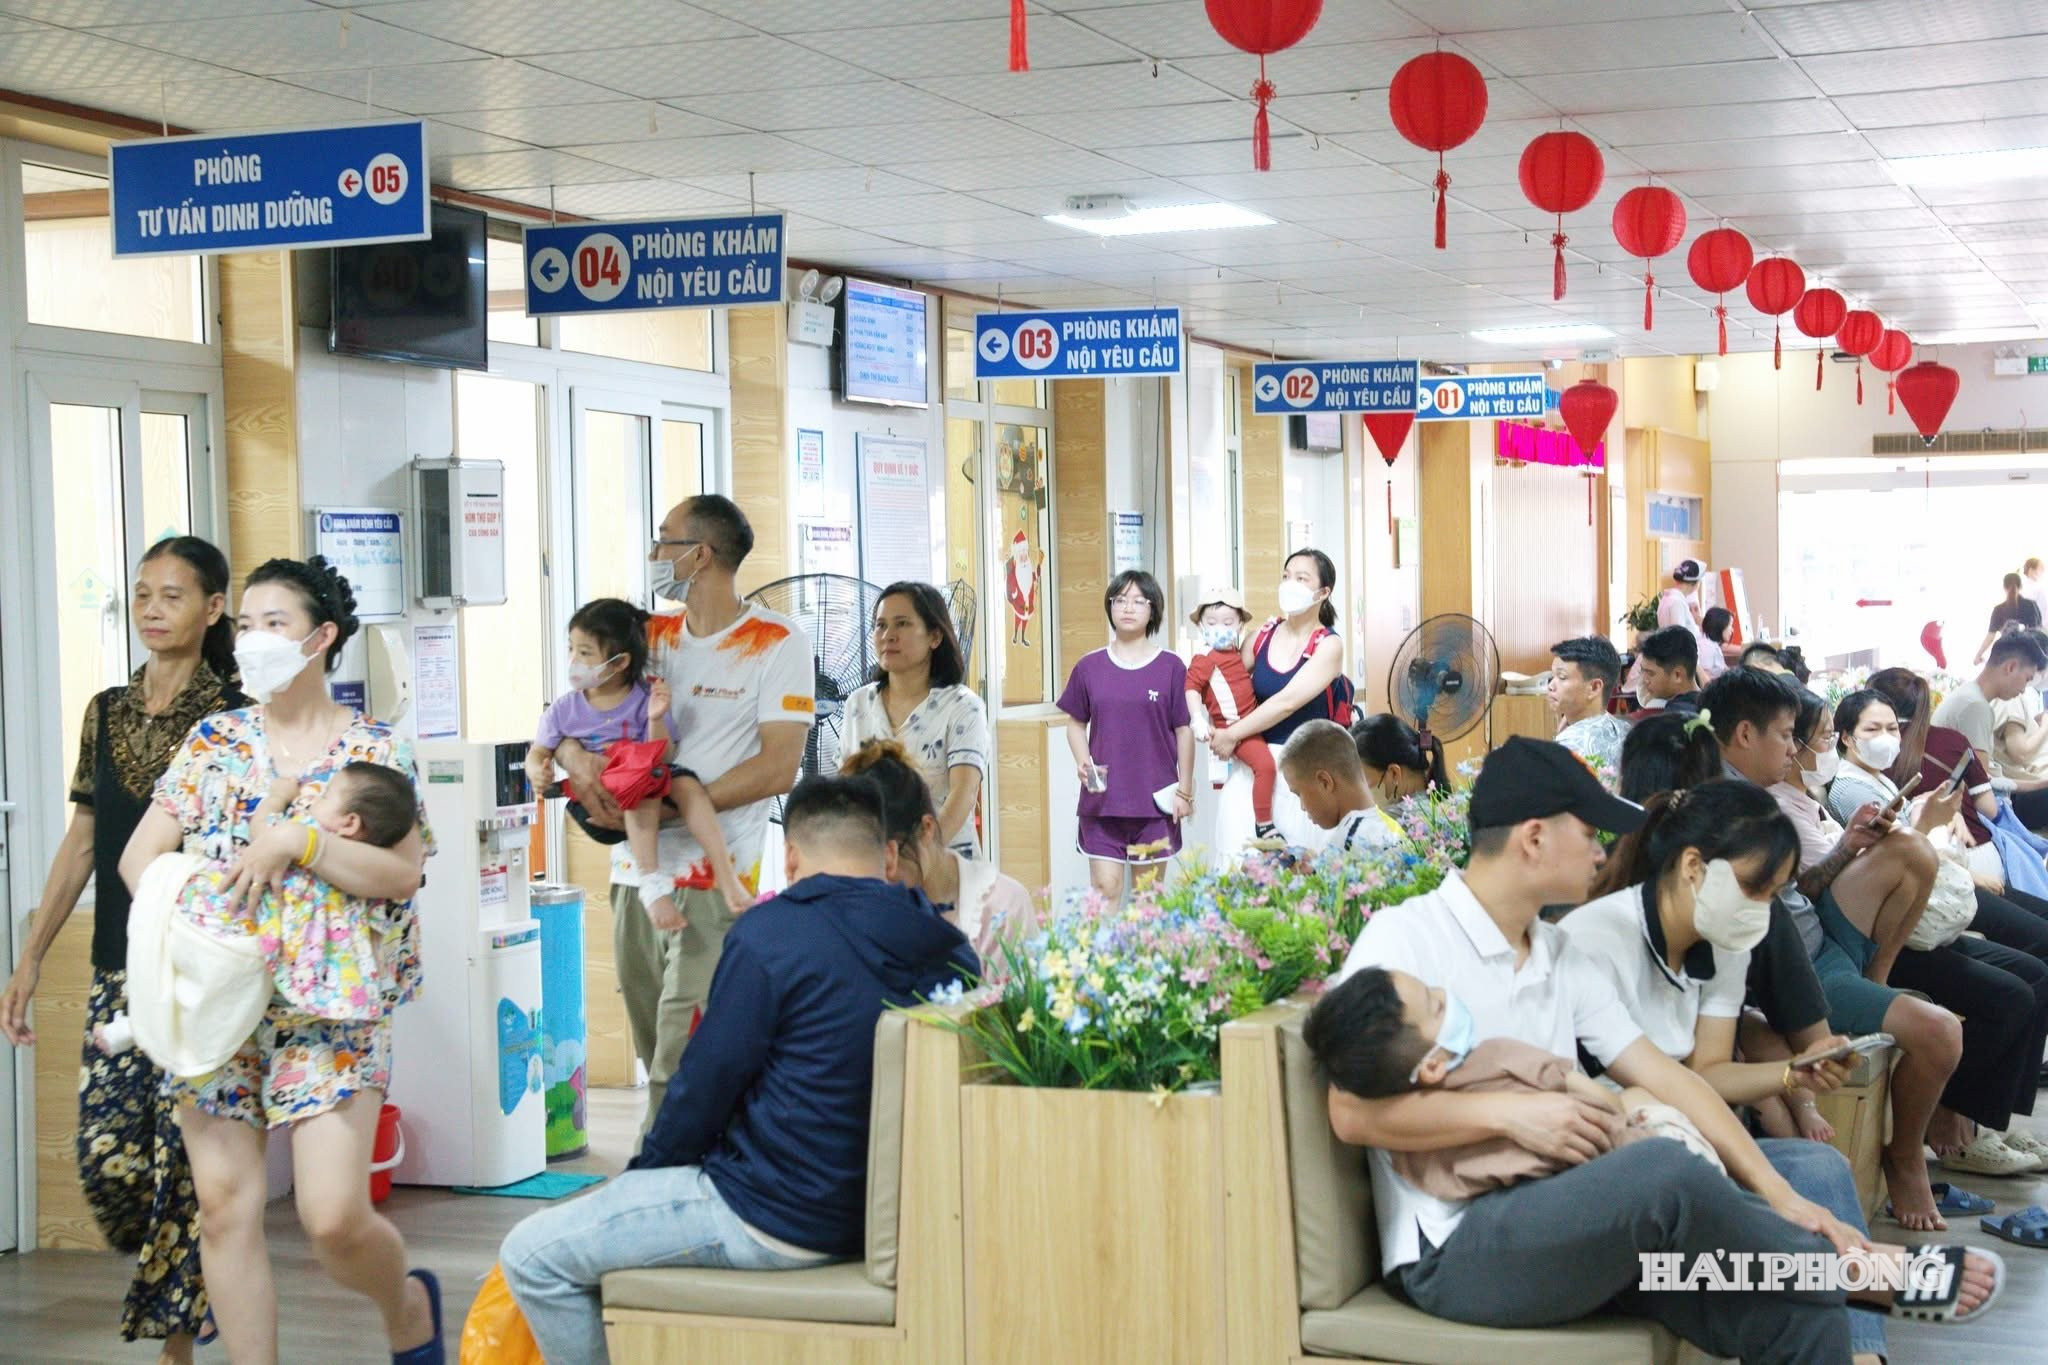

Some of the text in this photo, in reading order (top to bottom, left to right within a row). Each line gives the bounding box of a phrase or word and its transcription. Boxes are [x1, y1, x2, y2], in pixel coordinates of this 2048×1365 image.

[194, 151, 262, 186] PHÒNG
[372, 165, 400, 194] 05
[138, 190, 333, 238] TƯ VẤN DINH DƯỠNG
[632, 223, 777, 260] PHÒNG KHÁM
[579, 246, 622, 288] 04
[637, 260, 771, 304] NỘI YÊU CẦU
[1063, 314, 1177, 341] PHÒNG KHÁM
[1019, 328, 1053, 359] 03
[1067, 341, 1174, 373] NỘI YÊU CẦU
[1286, 375, 1314, 399] 02
[1322, 364, 1414, 384] PHÒNG KHÁM
[1467, 378, 1541, 396] PHÒNG KHÁM
[1325, 385, 1411, 409] NỘI YÊU CẦU
[1437, 388, 1459, 409] 01
[1469, 398, 1490, 416] NỘI
[1493, 397, 1514, 414] YÊU
[1517, 395, 1540, 413] CẦU
